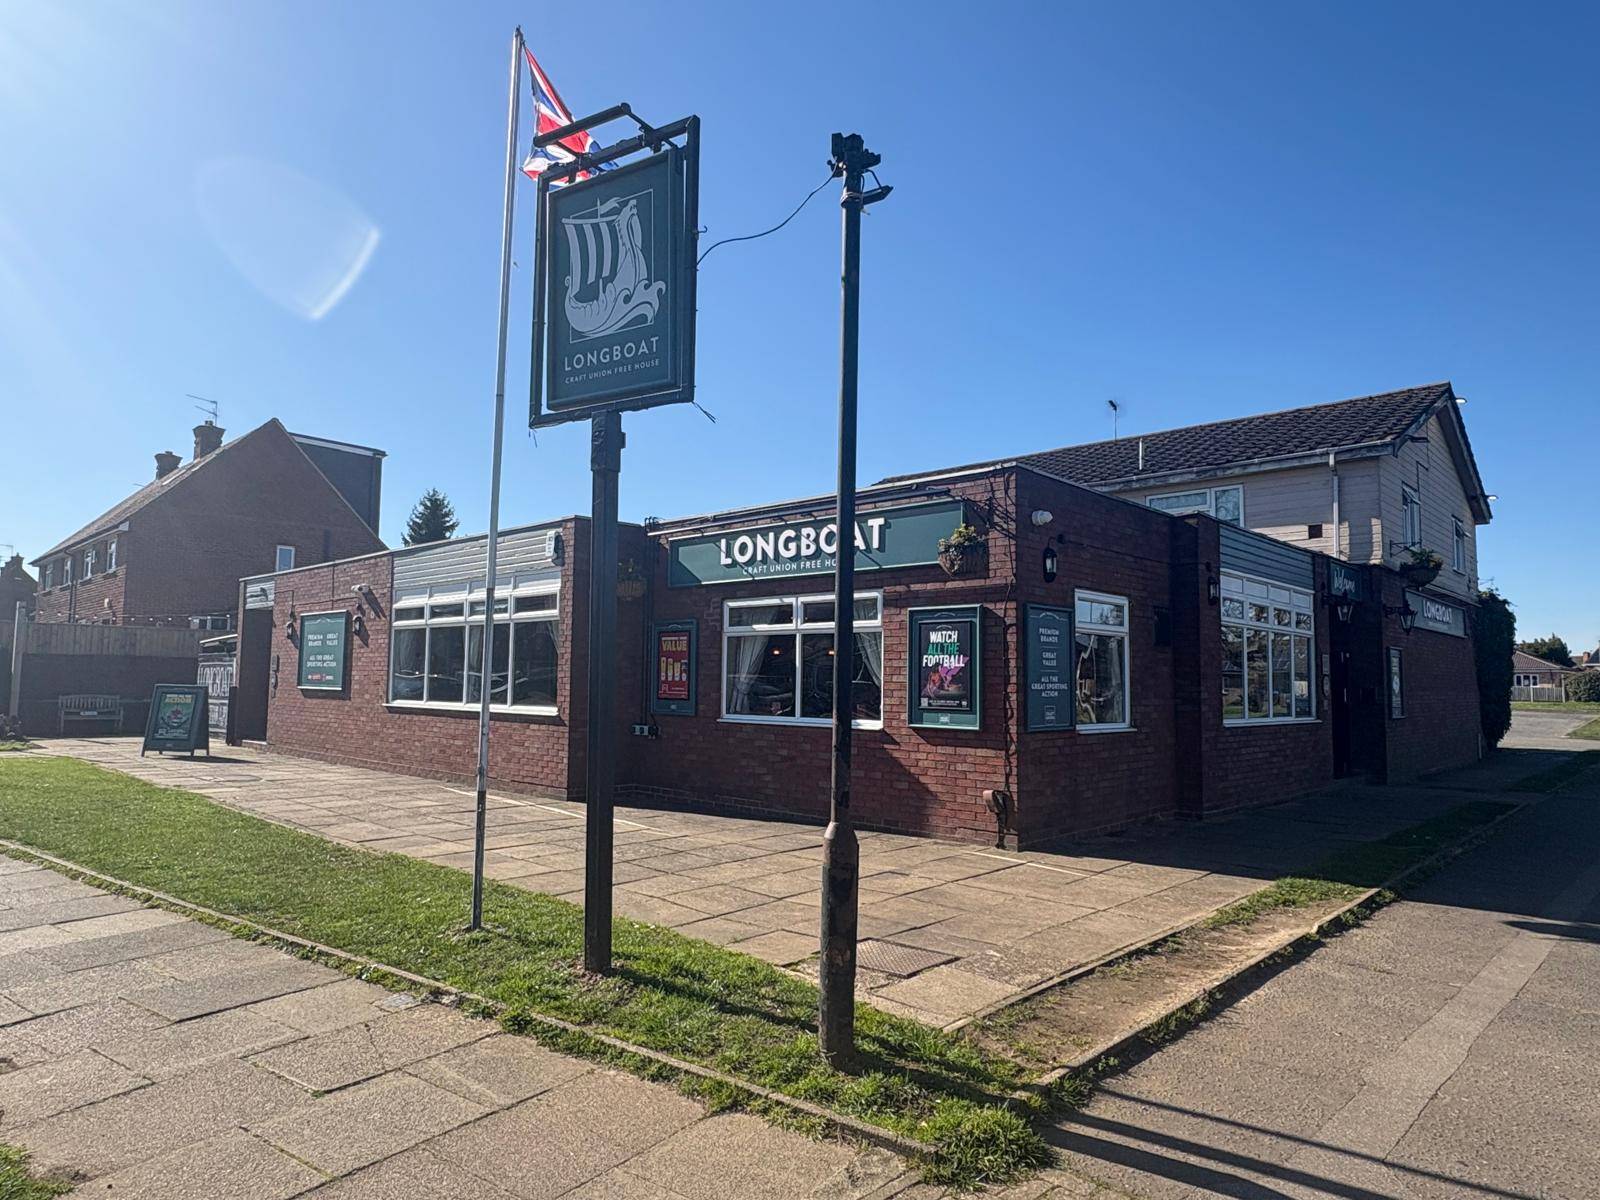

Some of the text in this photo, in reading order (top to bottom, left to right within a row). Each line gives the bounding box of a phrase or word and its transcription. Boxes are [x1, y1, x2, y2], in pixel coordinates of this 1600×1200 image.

[564, 336, 660, 371] LONGBOAT
[564, 358, 660, 384] CRAFT UNION FREE HOUSE
[742, 565, 768, 575] CRAFT
[769, 562, 797, 572] UNION
[800, 560, 822, 569] FREE
[1423, 599, 1453, 624] LONGBOAT
[929, 630, 959, 643] WATCH
[1039, 628, 1060, 636] PREMIUM
[1040, 635, 1059, 643] BRANDS
[661, 640, 688, 652] VALUE
[927, 642, 960, 655] ALL THE
[922, 654, 966, 669] FOOTBALL
[1042, 651, 1057, 659] GREAT
